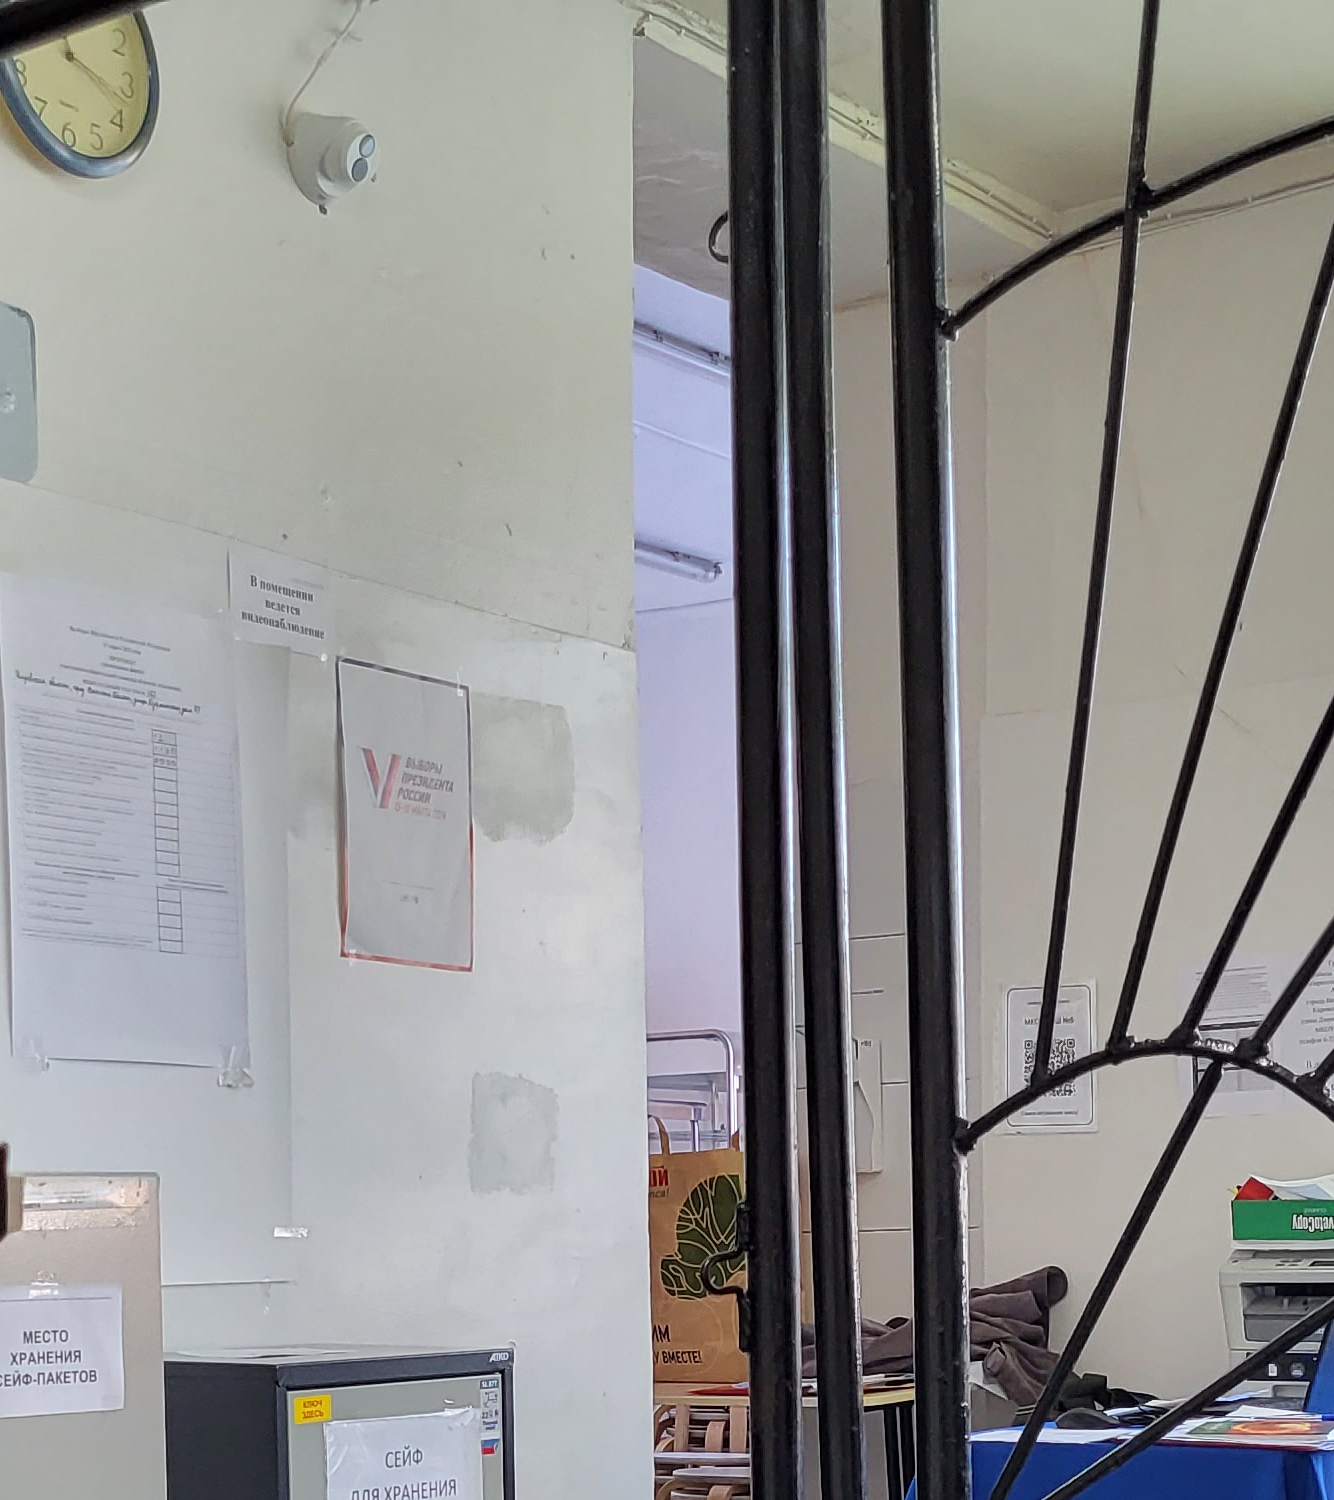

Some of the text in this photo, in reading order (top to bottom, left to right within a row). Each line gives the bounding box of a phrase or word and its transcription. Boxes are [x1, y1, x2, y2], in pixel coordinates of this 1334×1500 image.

[112, 28, 126, 57] 2
[119, 71, 135, 99] 3
[110, 108, 124, 133] 4
[61, 121, 77, 148] 6
[90, 122, 104, 151] 5
[250, 574, 258, 587] В
[259, 580, 314, 602] помещении
[265, 599, 301, 616] ведется
[241, 611, 325, 639] видеонаблюдение
[405, 757, 443, 775] ВЫБОРЫ
[401, 772, 455, 793] ПРЕЗИДЕНТА
[397, 787, 432, 804] РОССИИ
[22, 1329, 69, 1345] МЕСТО
[10, 1349, 82, 1366] ХРАНЕНИЯ
[662, 1350, 703, 1364] ВМЕСТЕ!
[302, 1399, 323, 1409] КЛЮЧ
[385, 1444, 424, 1469] СЕЙФ
